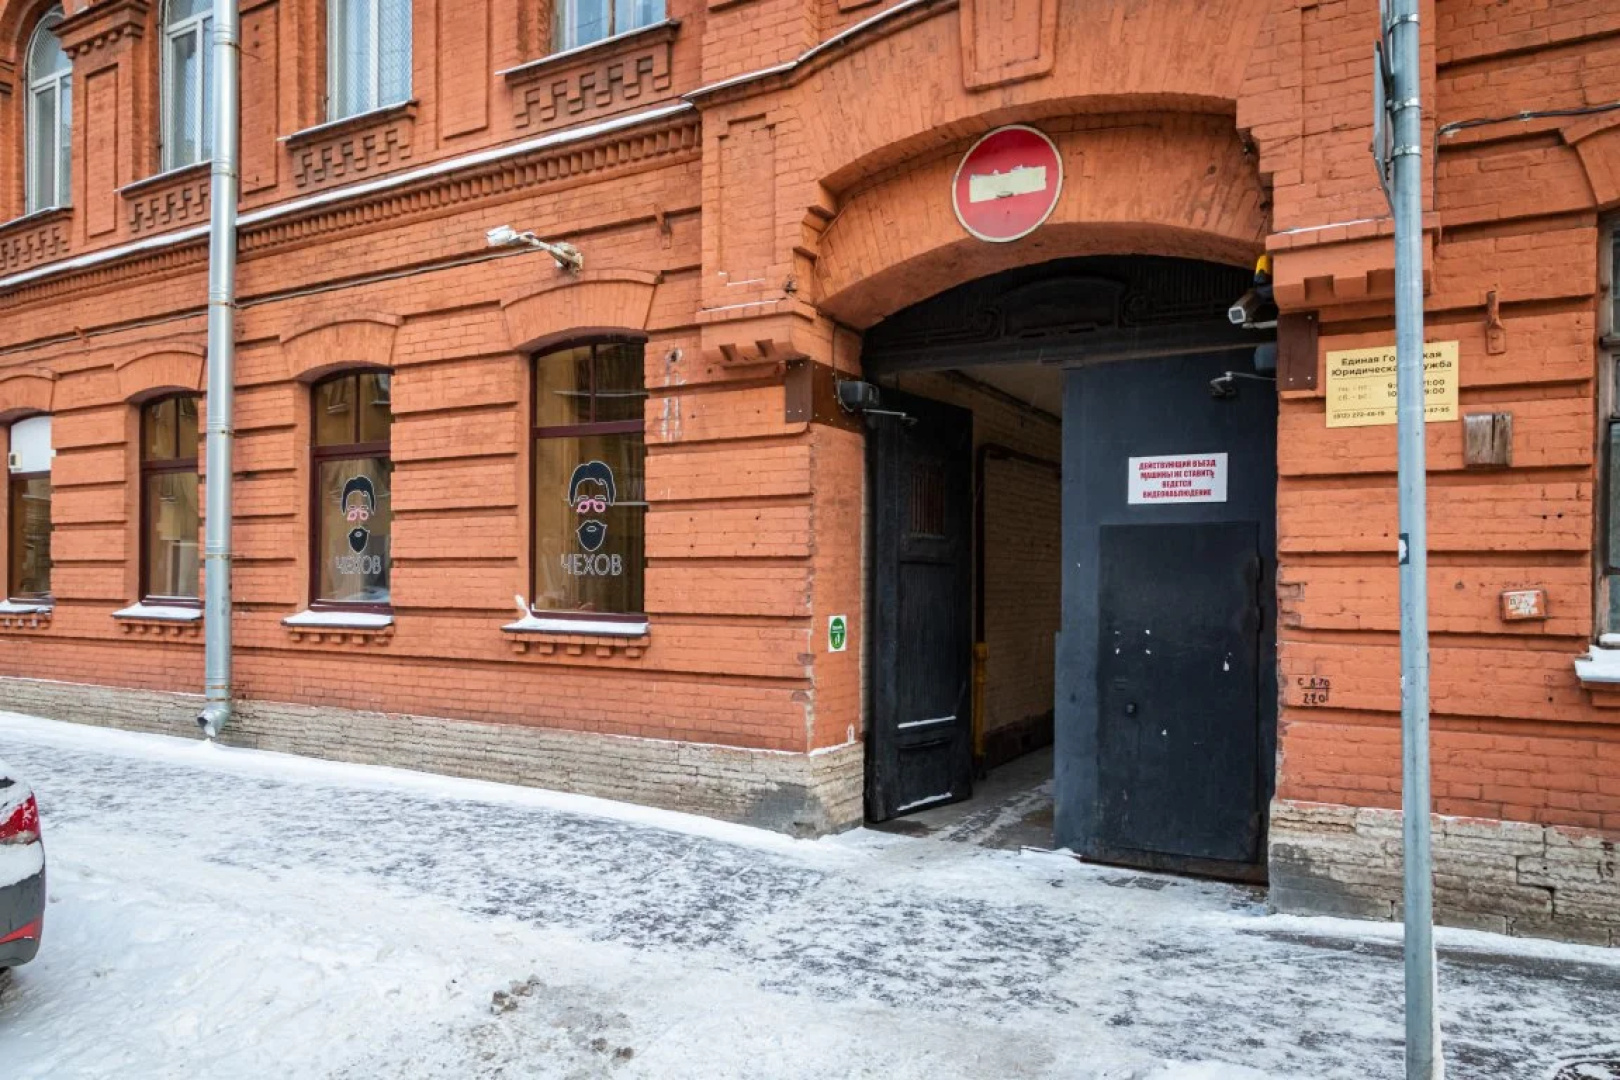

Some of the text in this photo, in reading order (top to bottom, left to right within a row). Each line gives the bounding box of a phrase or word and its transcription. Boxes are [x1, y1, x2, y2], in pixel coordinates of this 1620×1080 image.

[1341, 356, 1379, 366] Единая
[1139, 460, 1216, 470] ДЕЙСТВУЮЩИЙ ВЪЕЗД
[1140, 469, 1215, 479] МАШИНЫ НЕ СТАВИТЬ
[1142, 490, 1211, 498] ВИДЕОНАБЛЮДЕНИЕ
[335, 555, 382, 575] ЧЕХОВ
[560, 553, 622, 576] ЧЕХОВ
